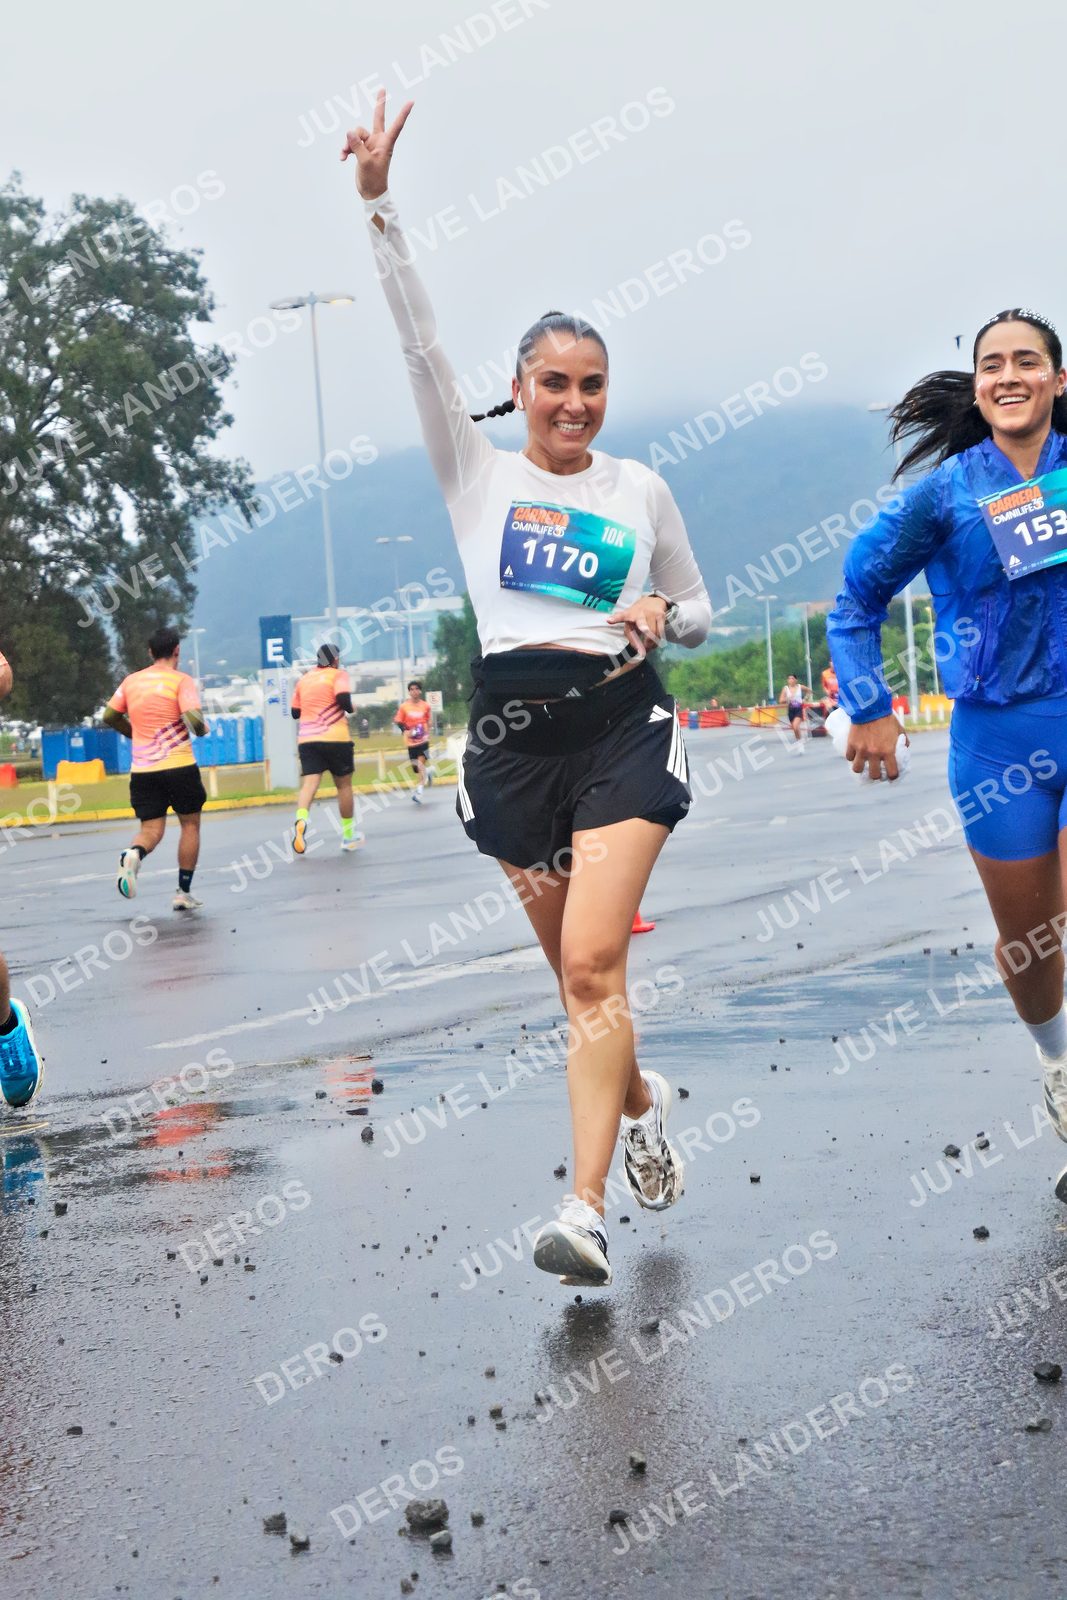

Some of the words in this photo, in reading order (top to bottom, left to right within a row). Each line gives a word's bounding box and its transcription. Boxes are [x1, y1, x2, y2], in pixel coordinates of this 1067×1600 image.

[989, 486, 1042, 516] CARRERA
[513, 507, 570, 527] CARRERA
[1014, 509, 1067, 546] 153
[601, 526, 626, 548] 10K
[523, 539, 599, 578] 1170
[266, 638, 285, 662] E
